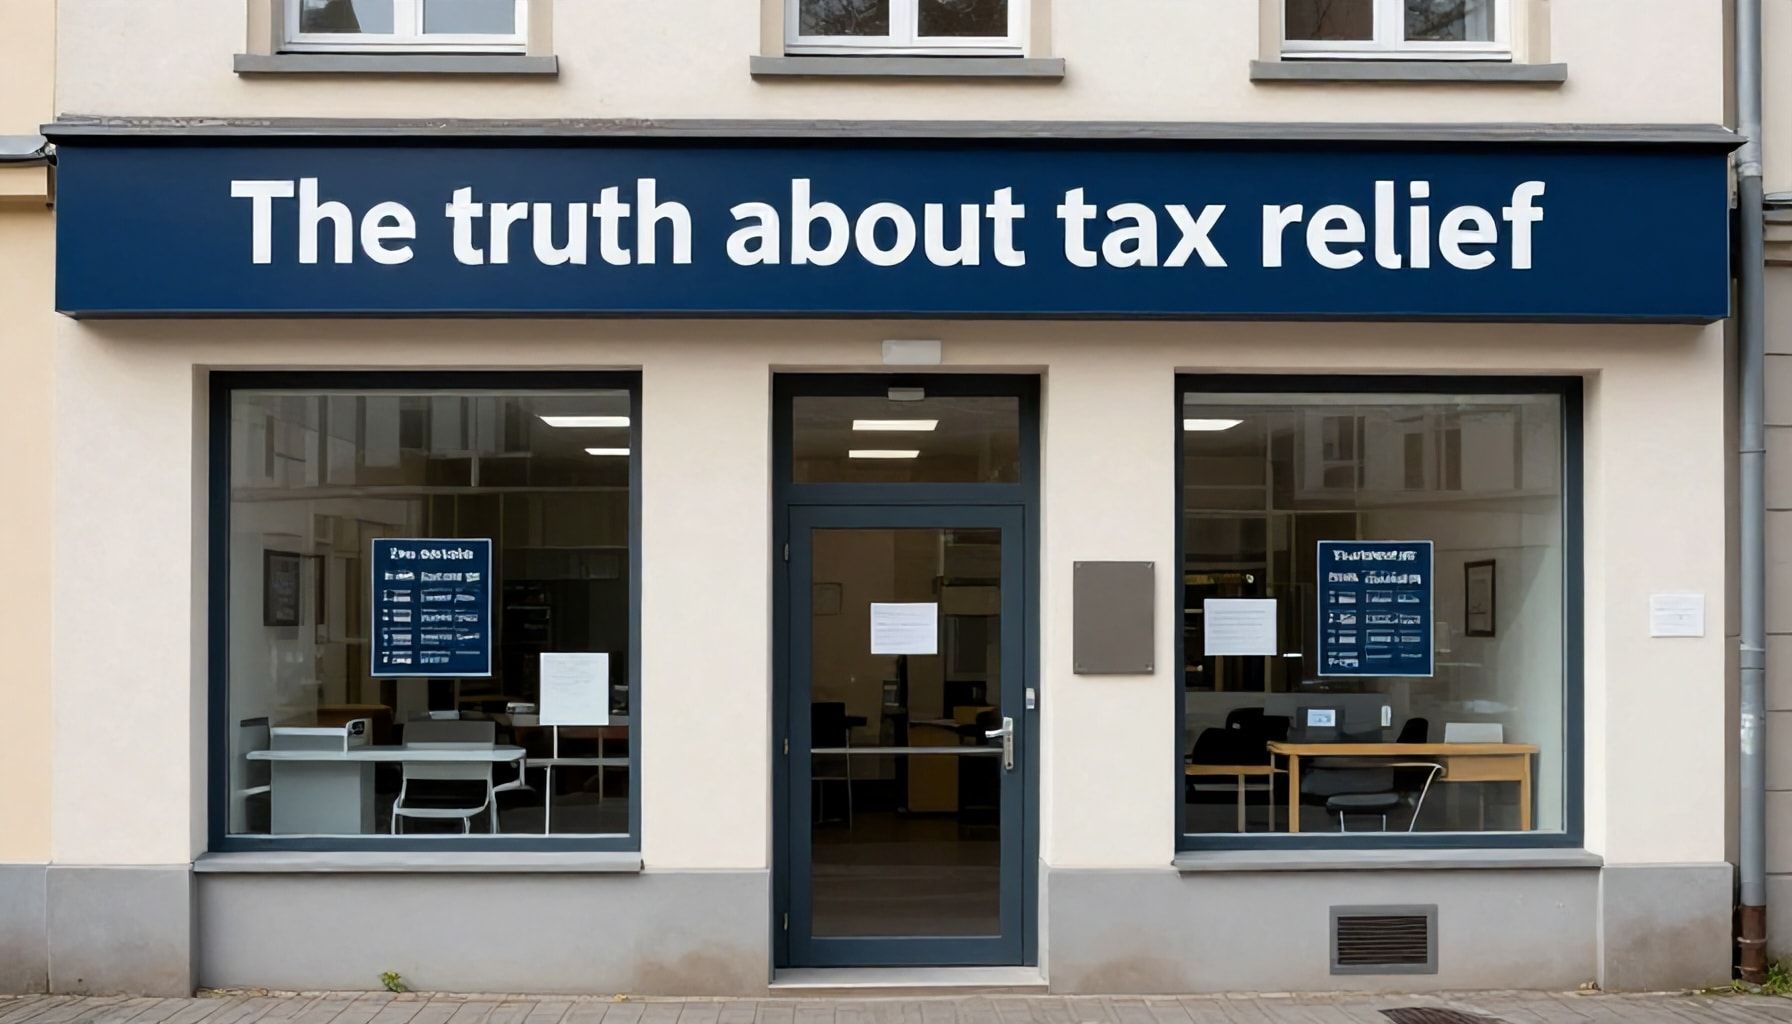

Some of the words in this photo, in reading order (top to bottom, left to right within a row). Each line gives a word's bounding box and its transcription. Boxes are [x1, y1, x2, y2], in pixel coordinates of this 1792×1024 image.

[230, 178, 416, 264] The
[445, 178, 692, 266] truth
[726, 178, 1026, 268] about
[1056, 187, 1228, 268] tax
[1262, 180, 1546, 270] relief
